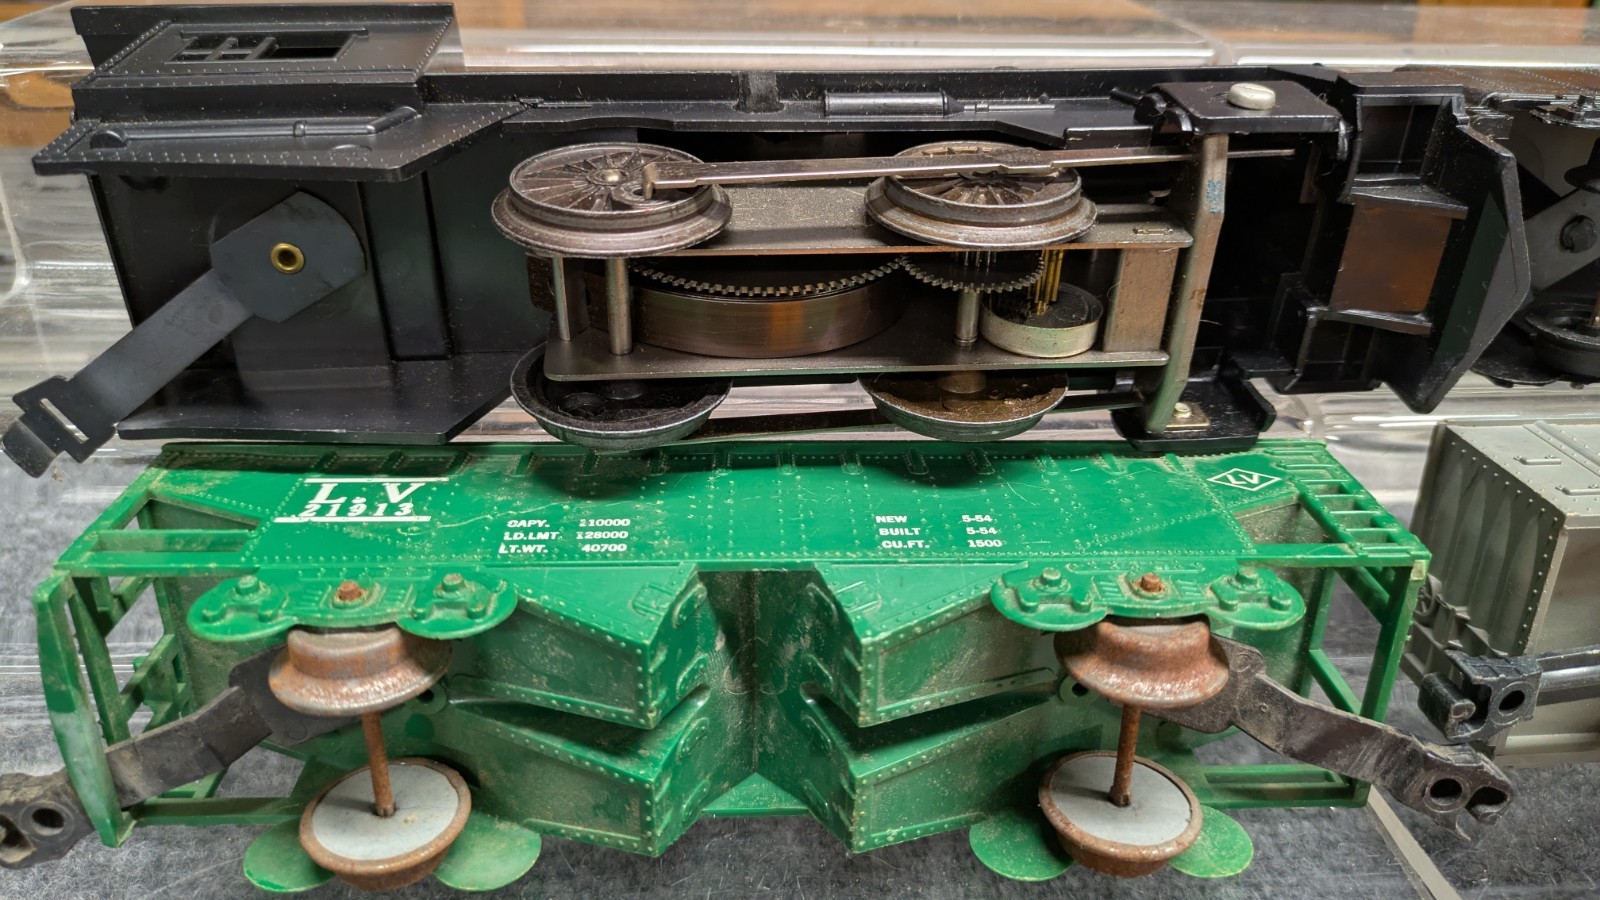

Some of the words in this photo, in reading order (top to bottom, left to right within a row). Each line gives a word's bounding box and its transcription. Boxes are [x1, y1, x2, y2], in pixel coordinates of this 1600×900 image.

[1226, 474, 1260, 485] LV
[506, 519, 550, 528] CAPY.
[875, 515, 907, 523] NEW
[961, 514, 993, 523] 5-54
[576, 530, 629, 540] 128000
[878, 527, 921, 536] BUILT
[966, 526, 997, 535] 5-54
[498, 543, 548, 554] LT.WT.
[581, 543, 627, 552] 40700
[881, 539, 930, 549] CU.FT.
[967, 539, 1003, 548] 1500
